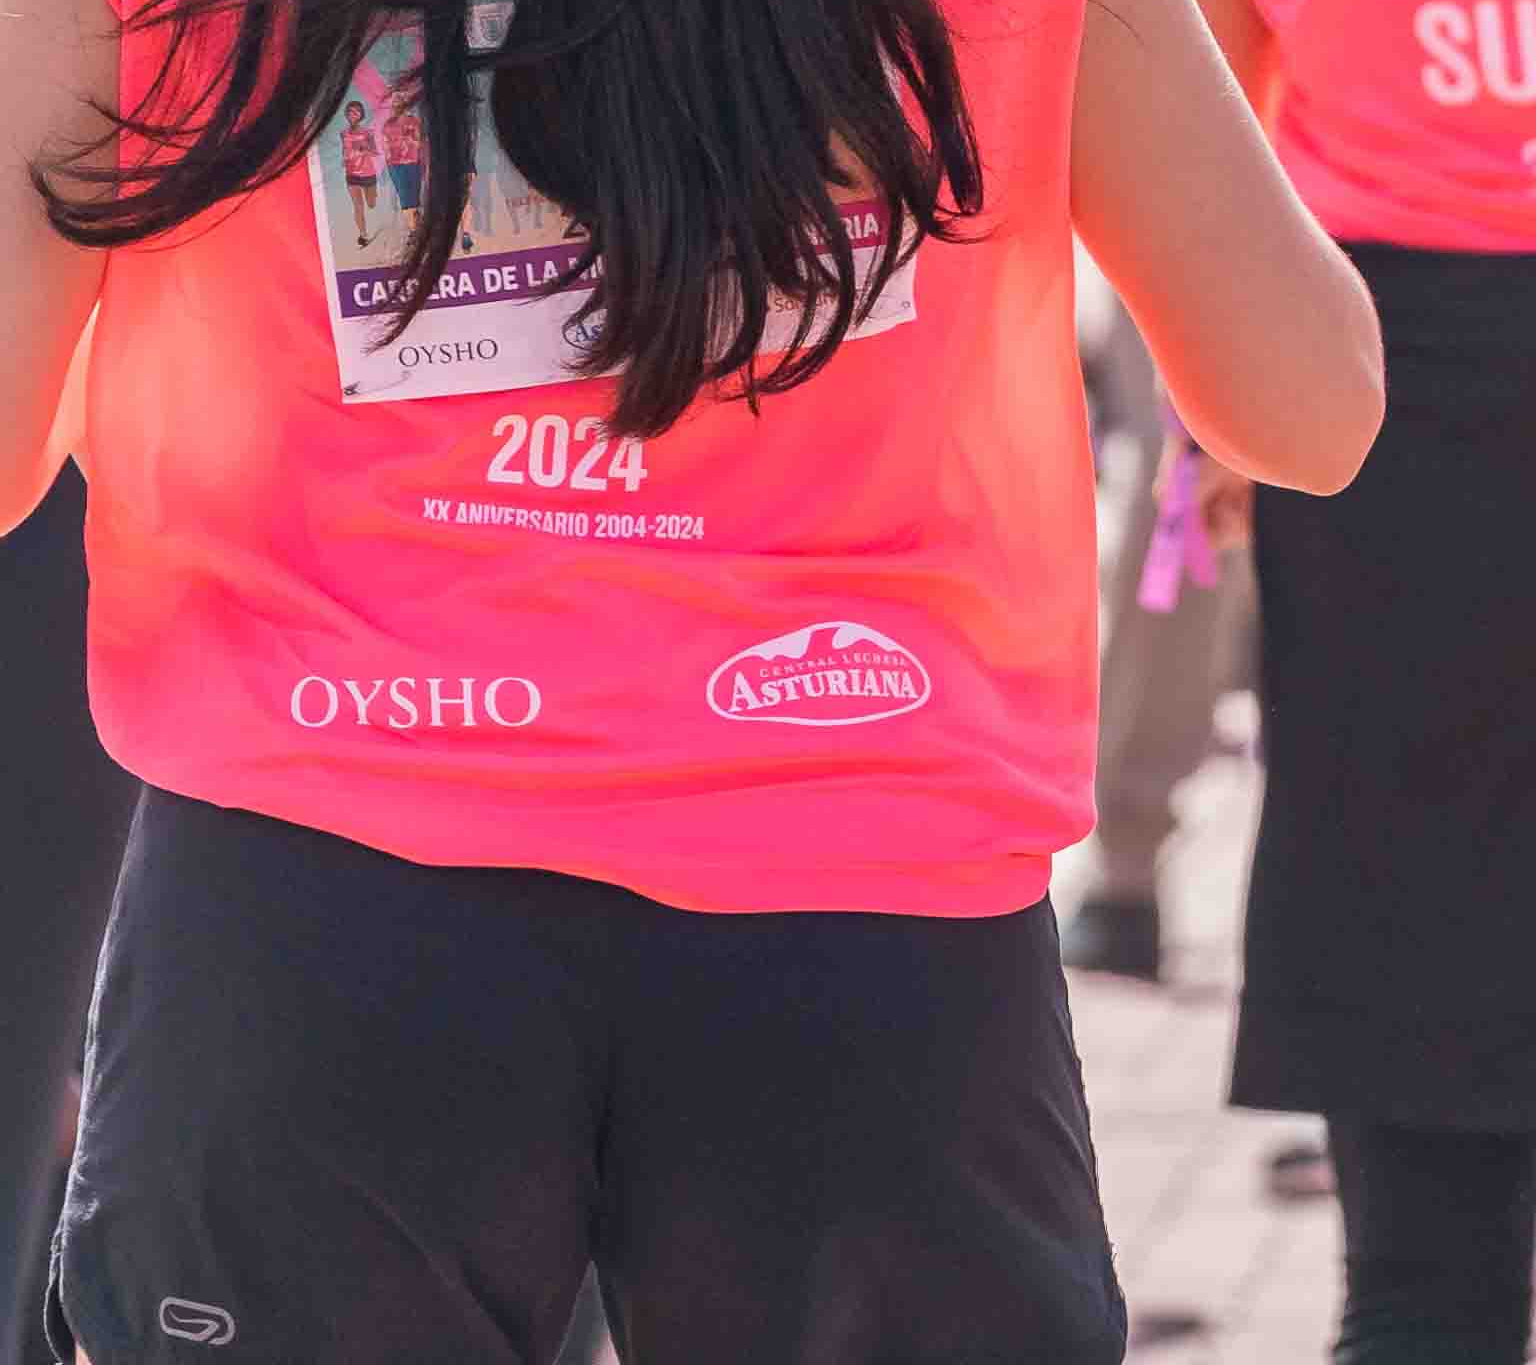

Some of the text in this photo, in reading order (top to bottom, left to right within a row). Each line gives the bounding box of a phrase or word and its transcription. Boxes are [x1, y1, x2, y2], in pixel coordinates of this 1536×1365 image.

[483, 266, 520, 293] DE
[526, 259, 559, 286] LA
[398, 338, 498, 368] OYSHO
[487, 414, 648, 492] 2024
[423, 498, 705, 541] XX ANIVERSARIO 2004-2024
[290, 674, 542, 729] OYSHO
[728, 670, 919, 712] ASTURIANA
